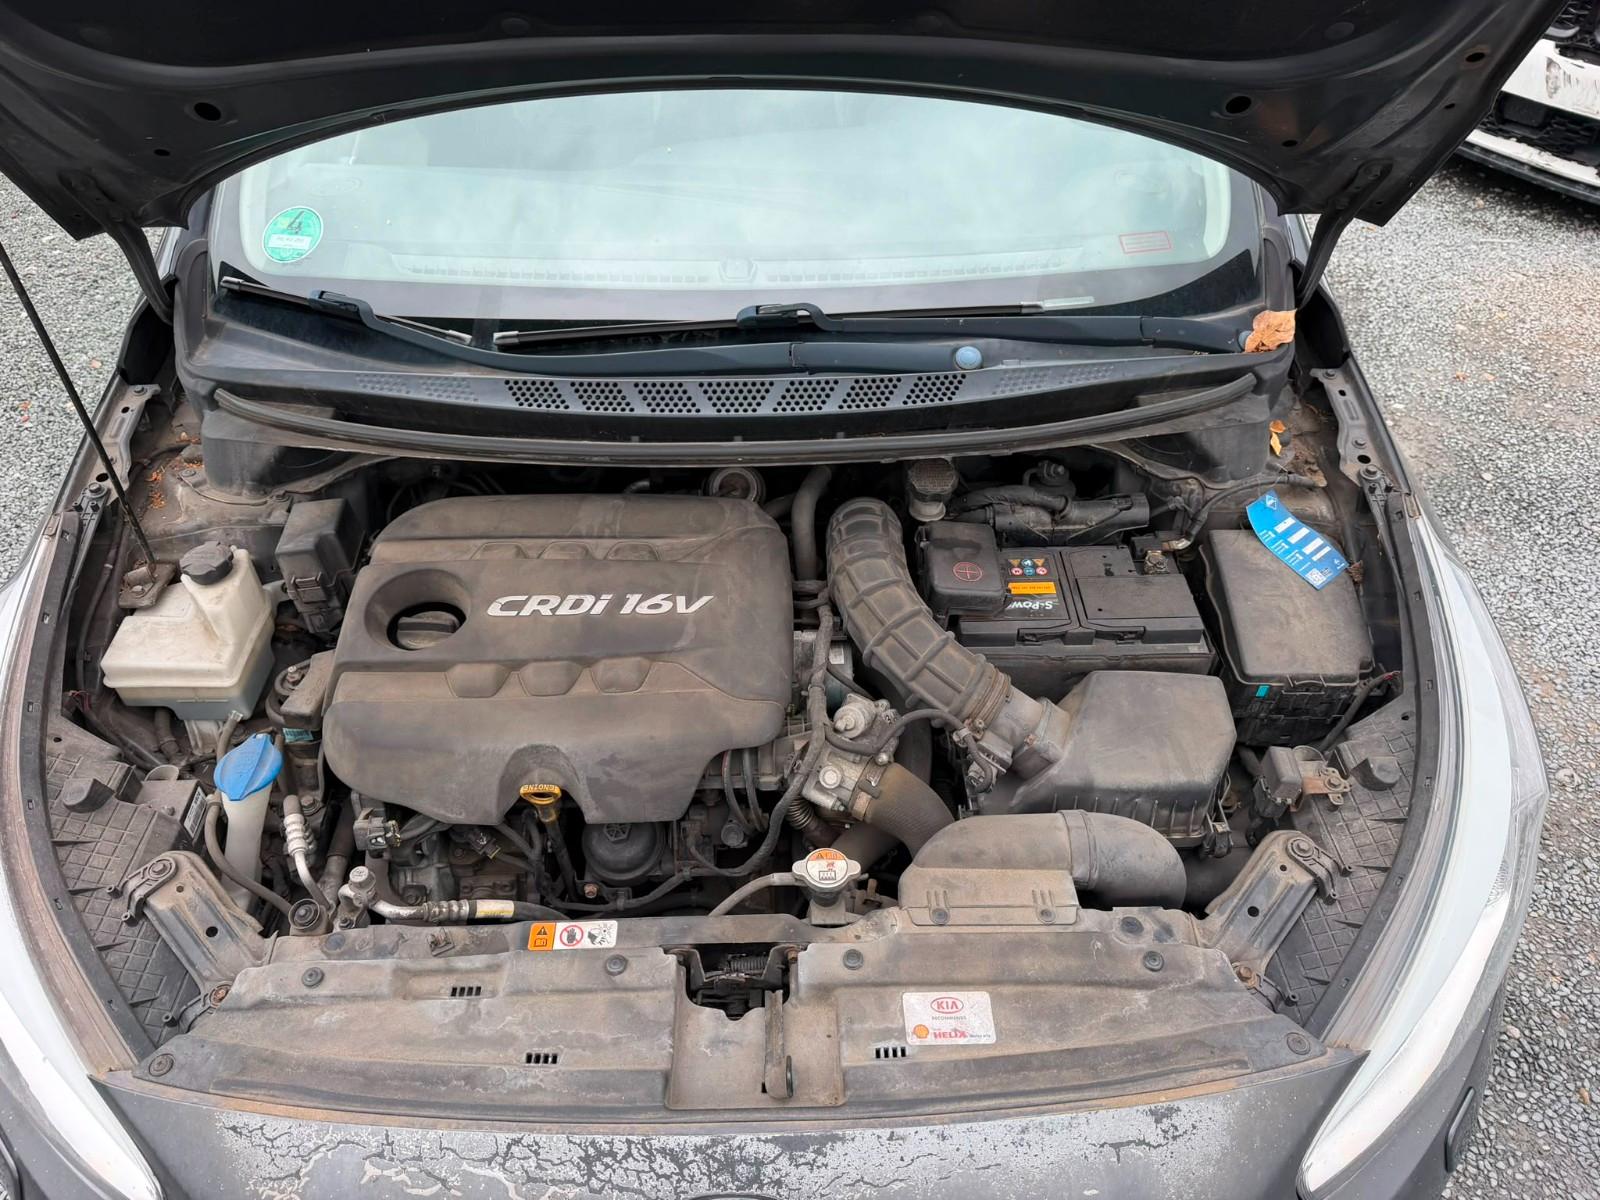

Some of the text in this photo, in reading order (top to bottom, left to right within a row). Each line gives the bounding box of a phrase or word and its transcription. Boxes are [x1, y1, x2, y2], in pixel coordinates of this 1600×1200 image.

[287, 211, 304, 235] 4
[487, 594, 714, 616] CRDi 16V
[936, 1001, 959, 1010] KIA
[933, 1031, 968, 1039] HELIX
